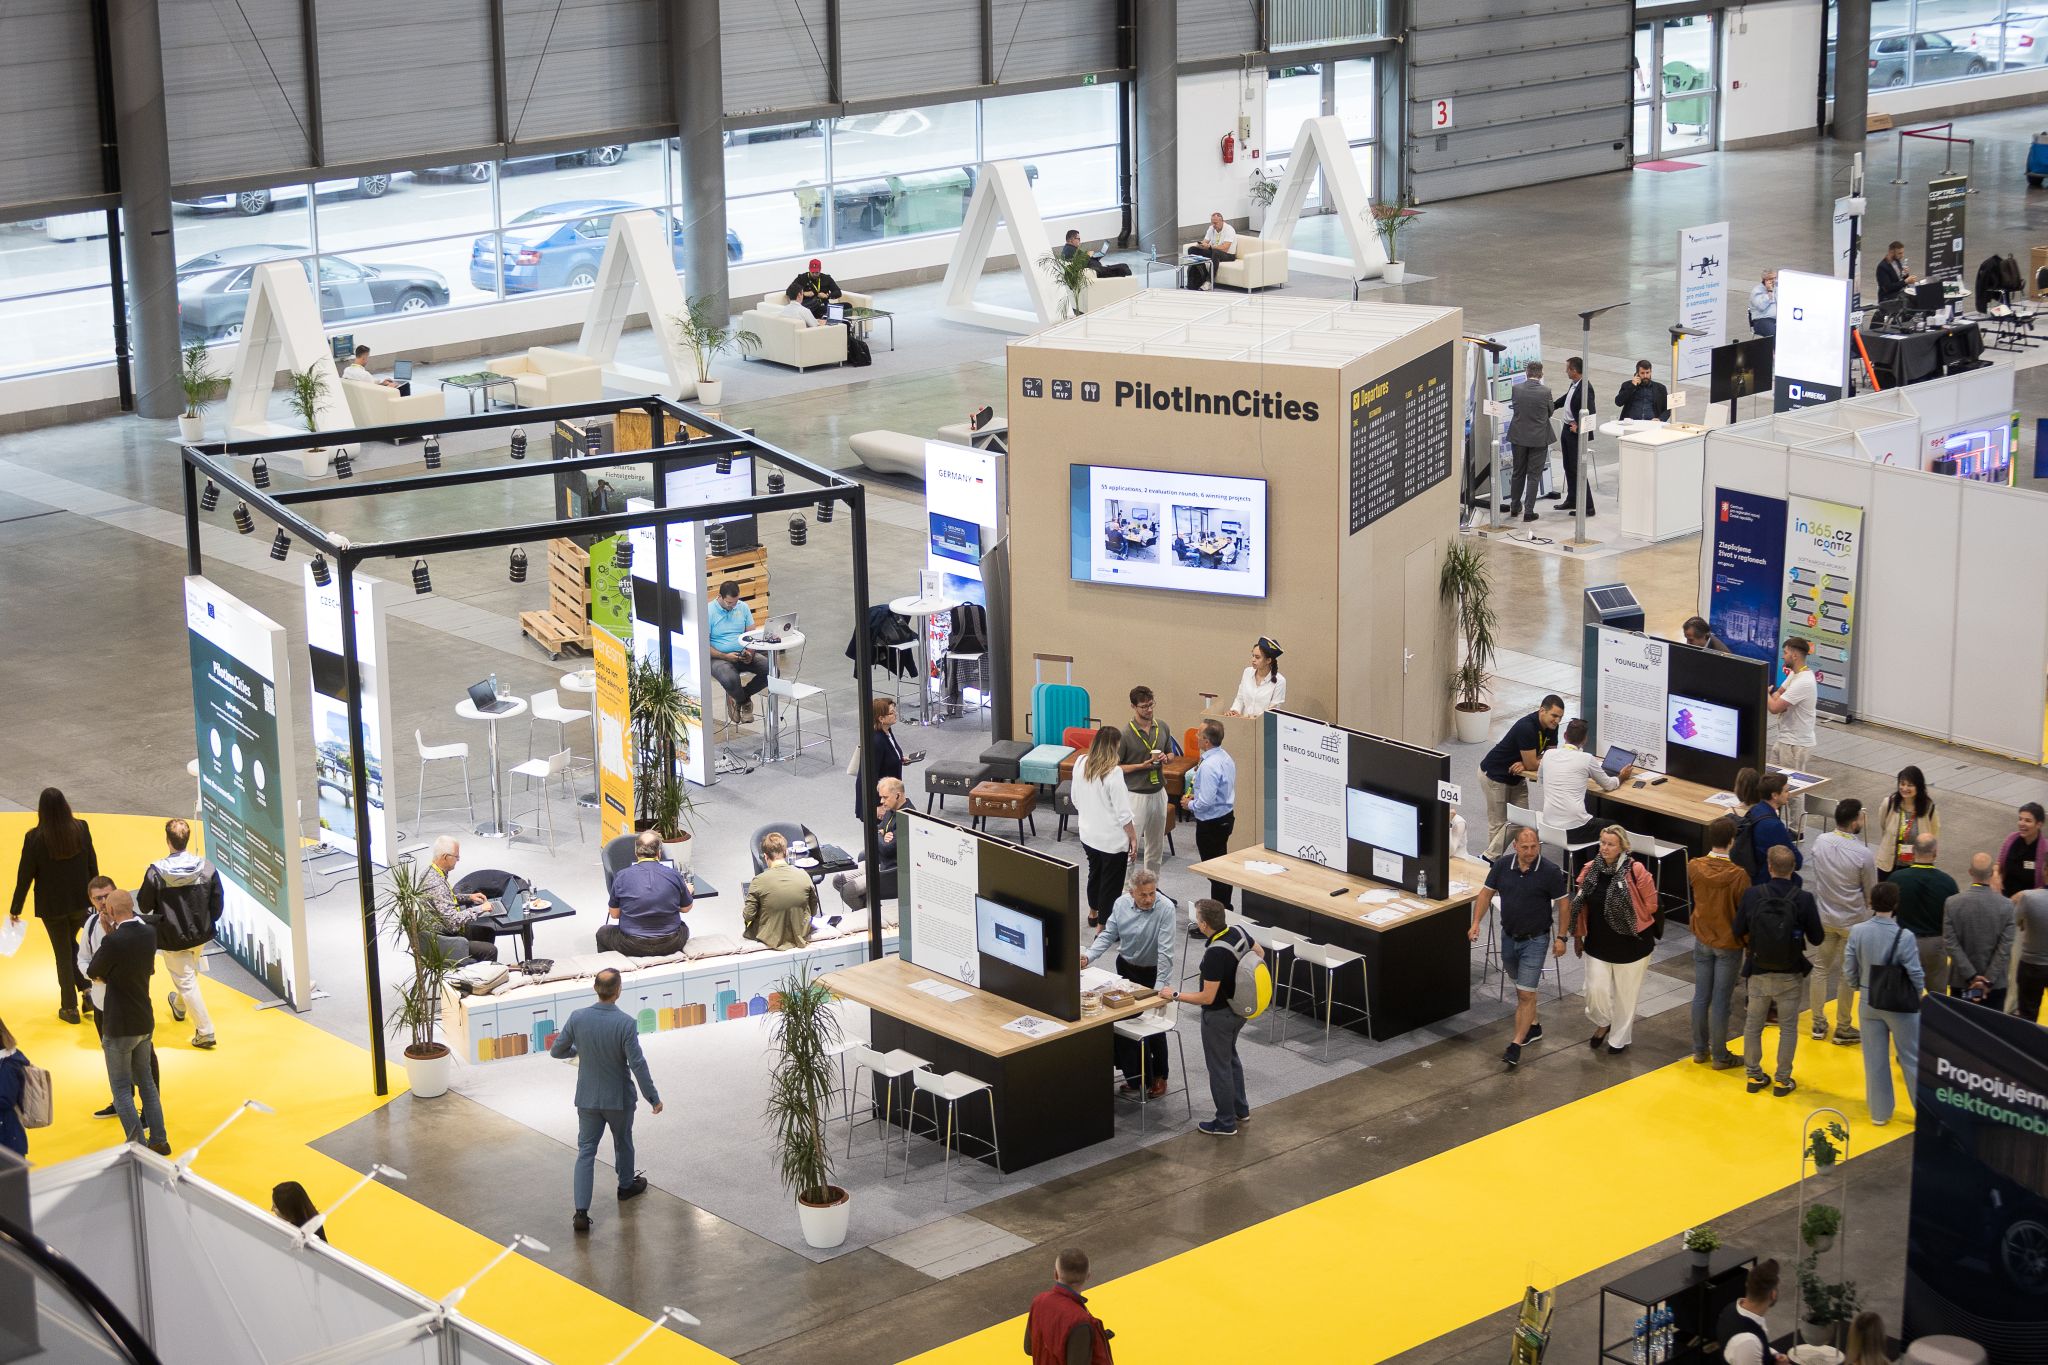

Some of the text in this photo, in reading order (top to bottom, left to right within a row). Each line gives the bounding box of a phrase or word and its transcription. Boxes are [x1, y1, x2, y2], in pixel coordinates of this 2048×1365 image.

[1437, 101, 1447, 125] 3
[1027, 389, 1038, 397] TRL
[1056, 391, 1068, 399] MVP
[1115, 381, 1319, 421] PilotInnCities
[1361, 381, 1389, 407] Departures
[1369, 410, 1395, 430] INNOVATION
[1368, 430, 1394, 449] PROSPERITY
[1368, 438, 1397, 460] DEVELOPMENT
[1368, 448, 1397, 470] CO-CREATION
[605, 471, 645, 481] Fichtelgebirge
[938, 469, 972, 483] GERMANY
[1368, 461, 1392, 480] ECOSYSTEM
[1368, 469, 1394, 490] GOVERNANCE
[1149, 488, 1178, 496] evaluation
[1206, 493, 1227, 501] winning
[1368, 483, 1386, 499] SYNERGY
[1368, 489, 1394, 510] VALIDATION
[1368, 498, 1394, 520] EXCELLENCE
[1795, 518, 1852, 543] in365.cz
[1718, 541, 1752, 554] Zlepšujeme
[1718, 549, 1733, 559] život
[1615, 657, 1649, 670] YOUNGLINK
[1283, 743, 1340, 765] ENERCO SOLUTIONS
[1440, 789, 1459, 802] 094
[927, 851, 957, 867] NEXTDROP
[1936, 1057, 2048, 1111] Propojujem
[1935, 1086, 2048, 1137] elektromob
